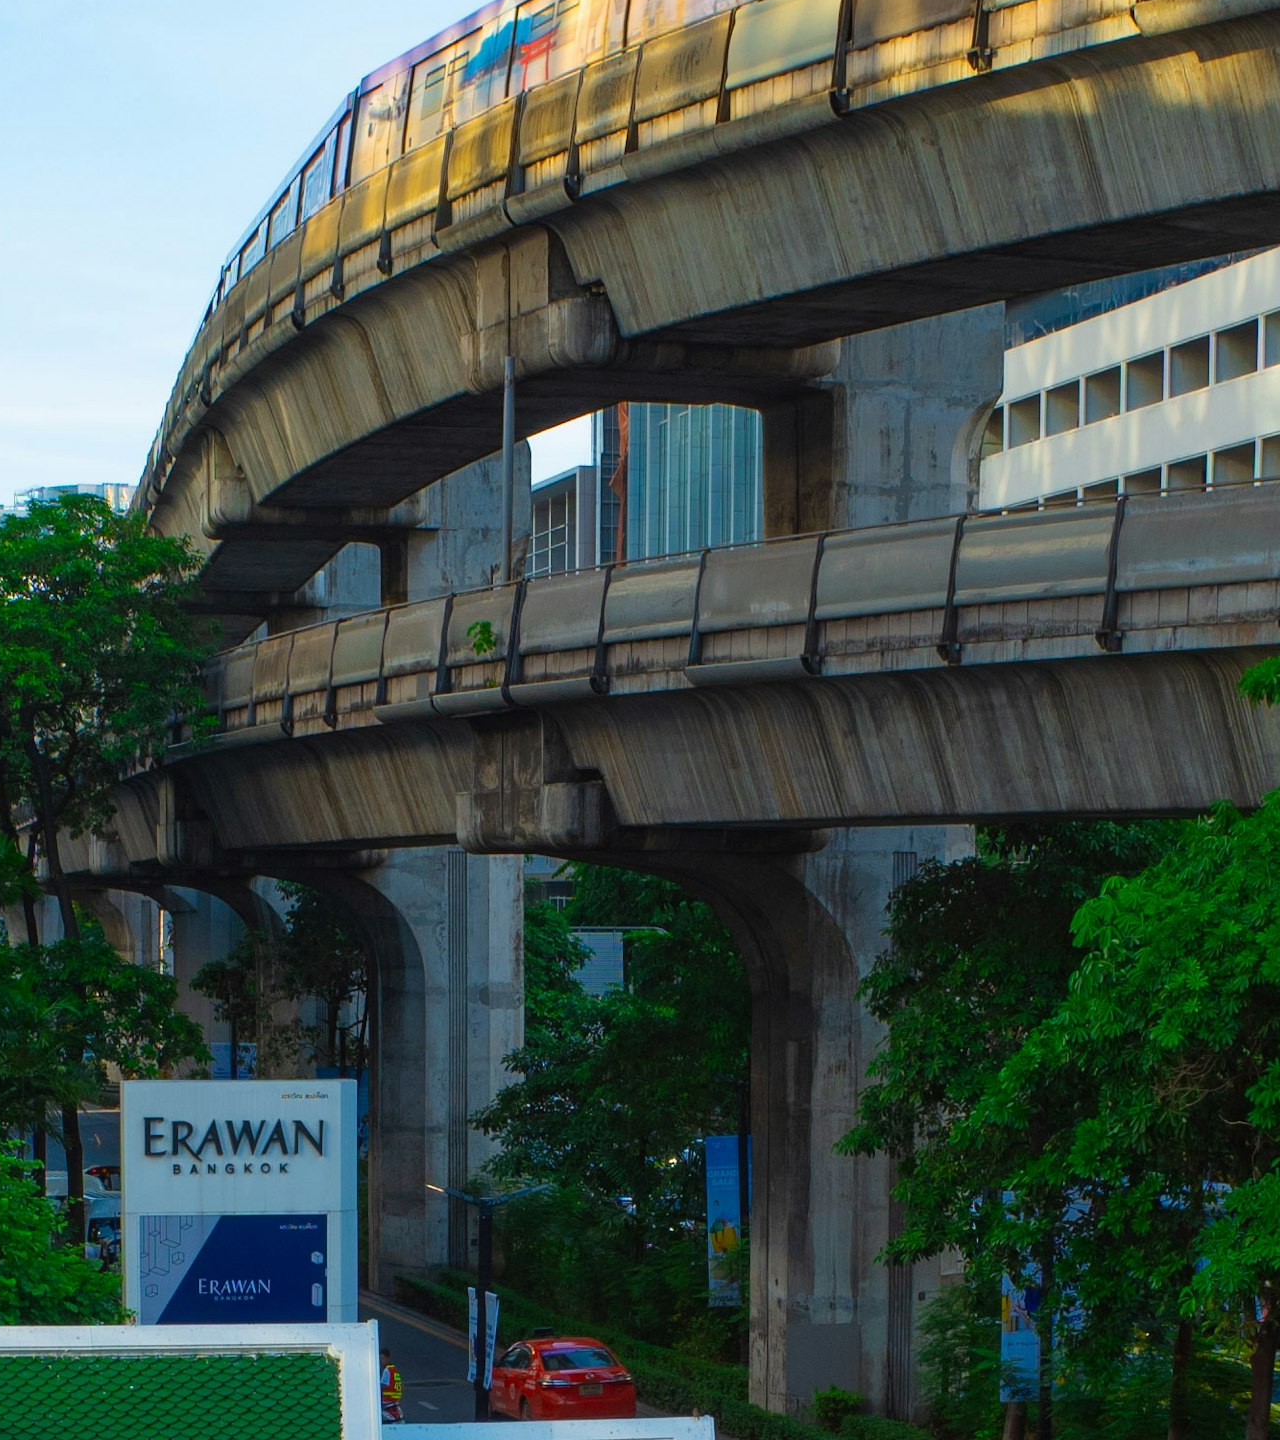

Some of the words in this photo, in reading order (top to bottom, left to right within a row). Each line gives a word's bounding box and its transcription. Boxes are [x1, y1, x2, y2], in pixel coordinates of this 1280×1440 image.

[143, 1117, 325, 1161] ERAWAN
[172, 1163, 289, 1175] BANGKOK
[198, 1278, 271, 1296] ERAWAN
